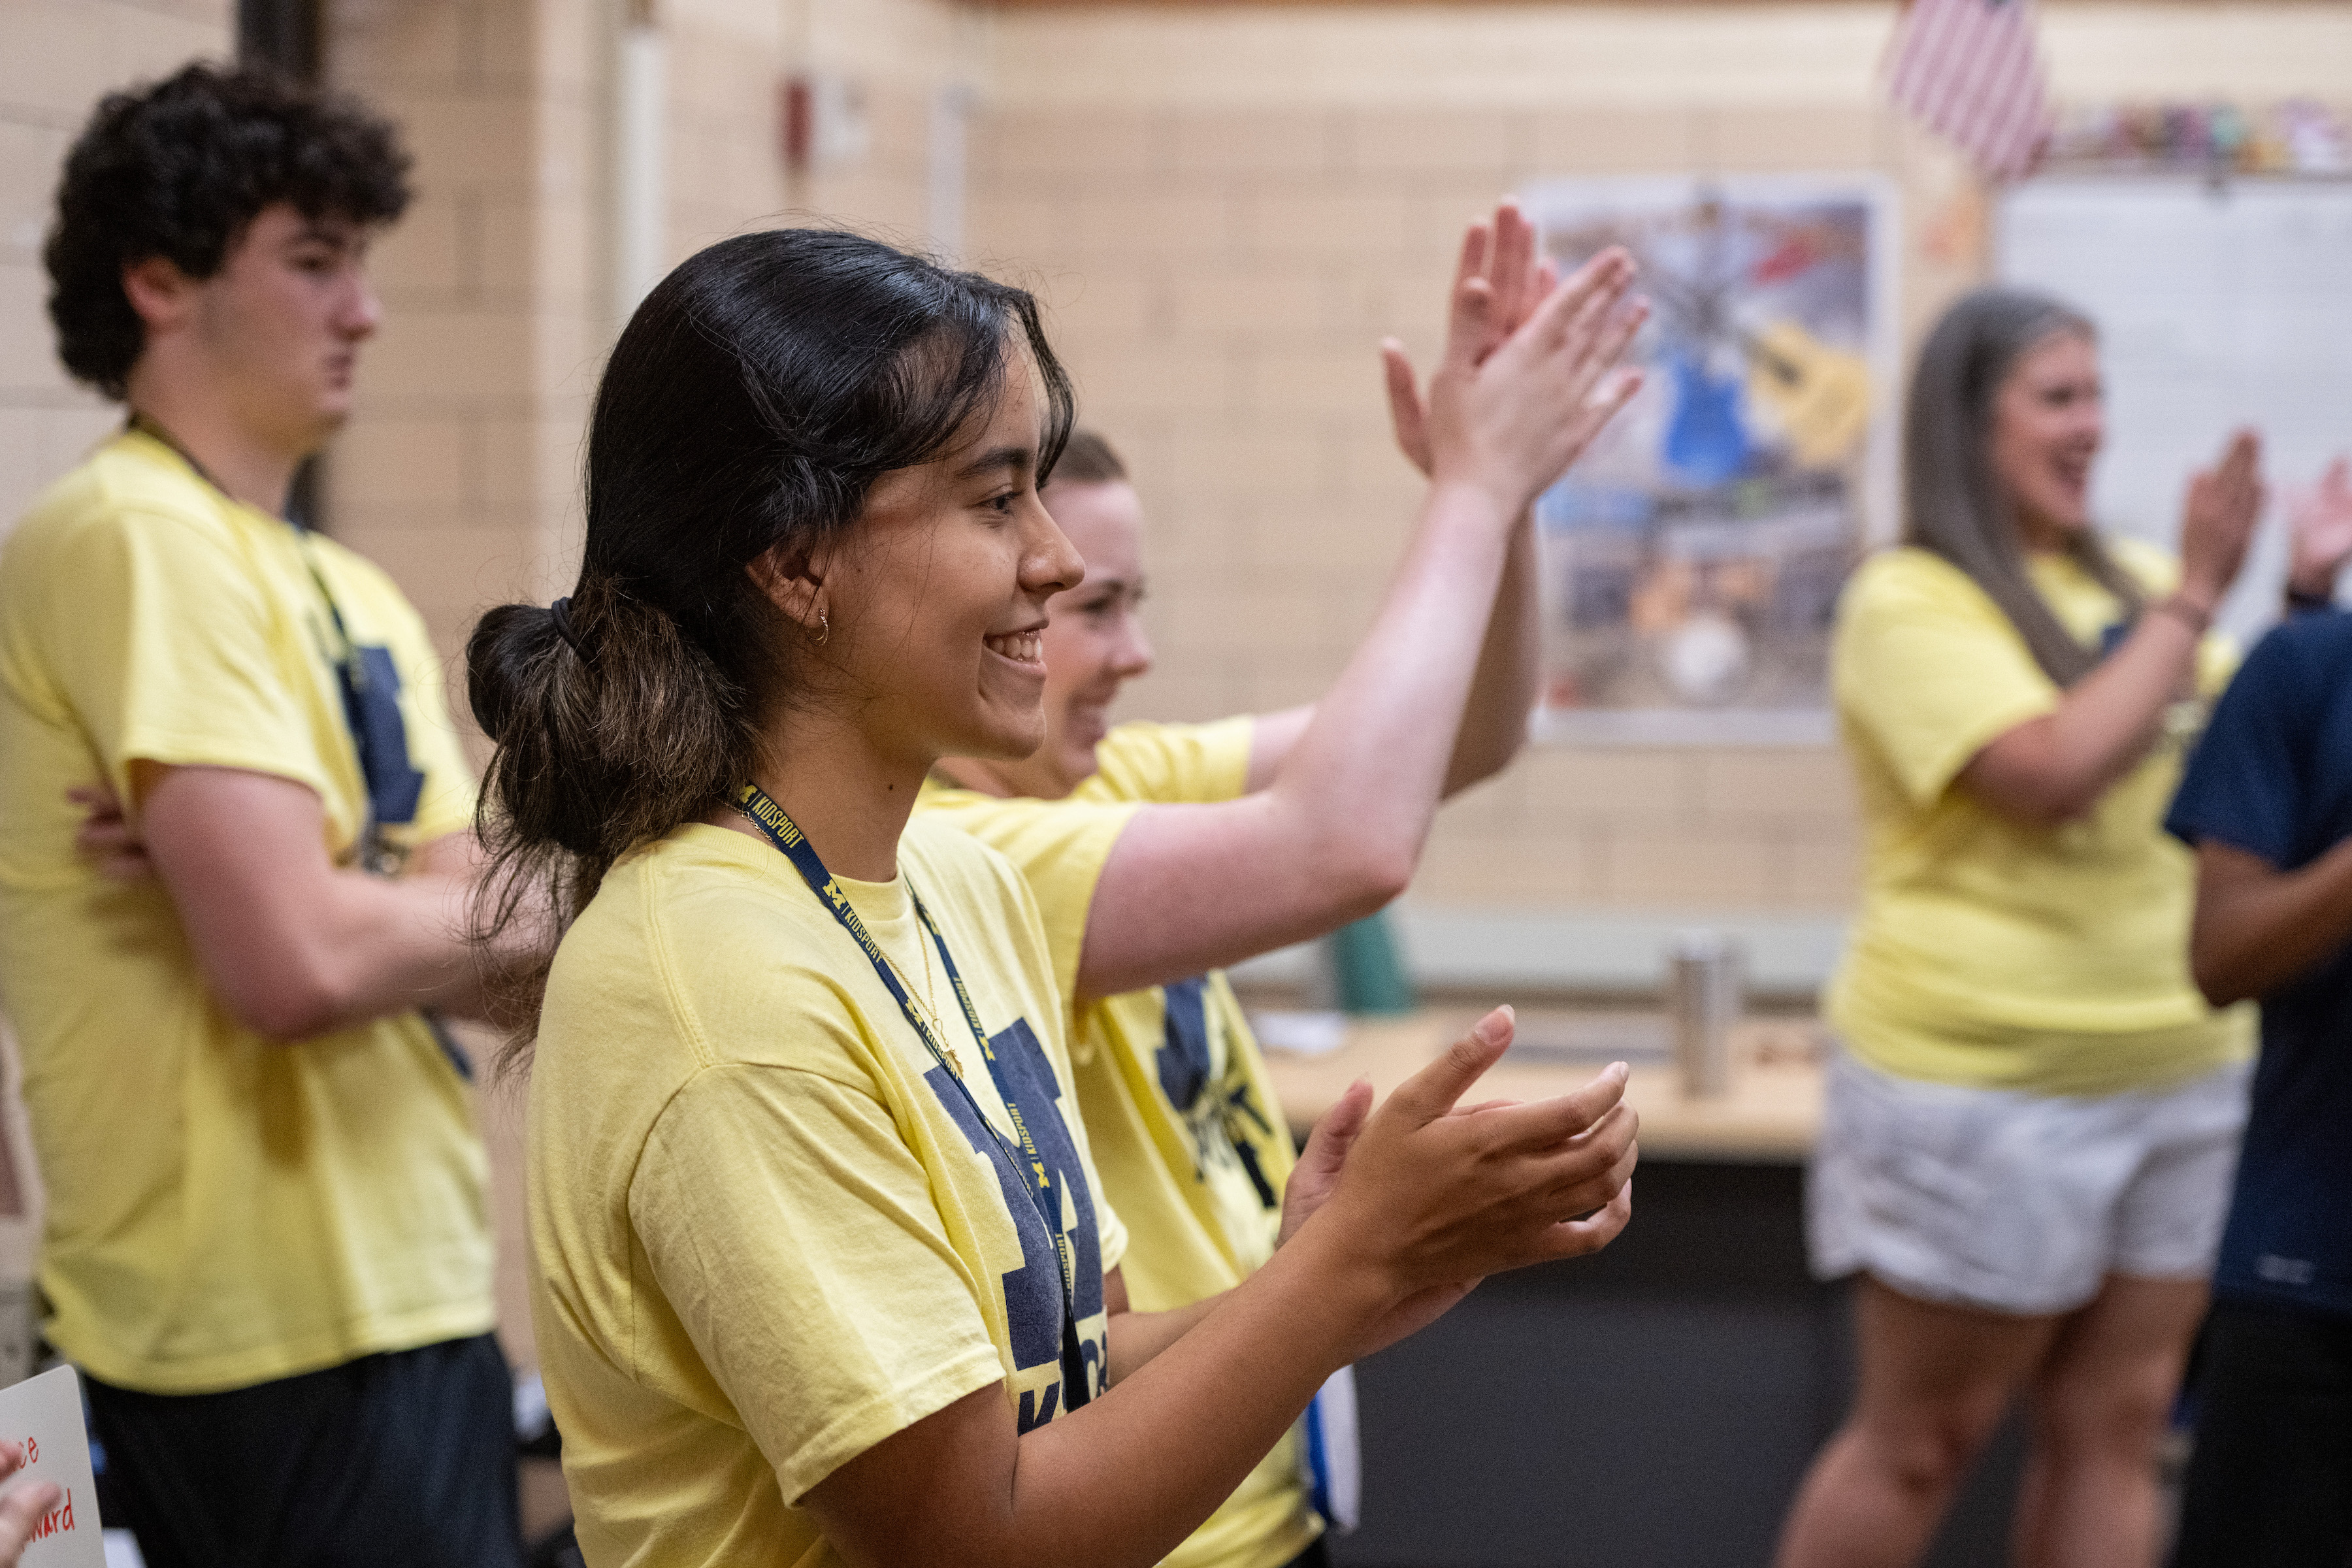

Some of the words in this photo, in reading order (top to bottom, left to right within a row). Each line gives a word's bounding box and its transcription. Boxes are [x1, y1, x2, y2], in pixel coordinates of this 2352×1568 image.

[751, 796, 804, 849] KIDSPORT
[823, 879, 847, 910] M
[845, 910, 883, 964] KIDSPORT
[925, 1029, 960, 1080] KIDSPORT
[1007, 1102, 1037, 1154] KIDSPORT
[1031, 1162, 1051, 1188] M
